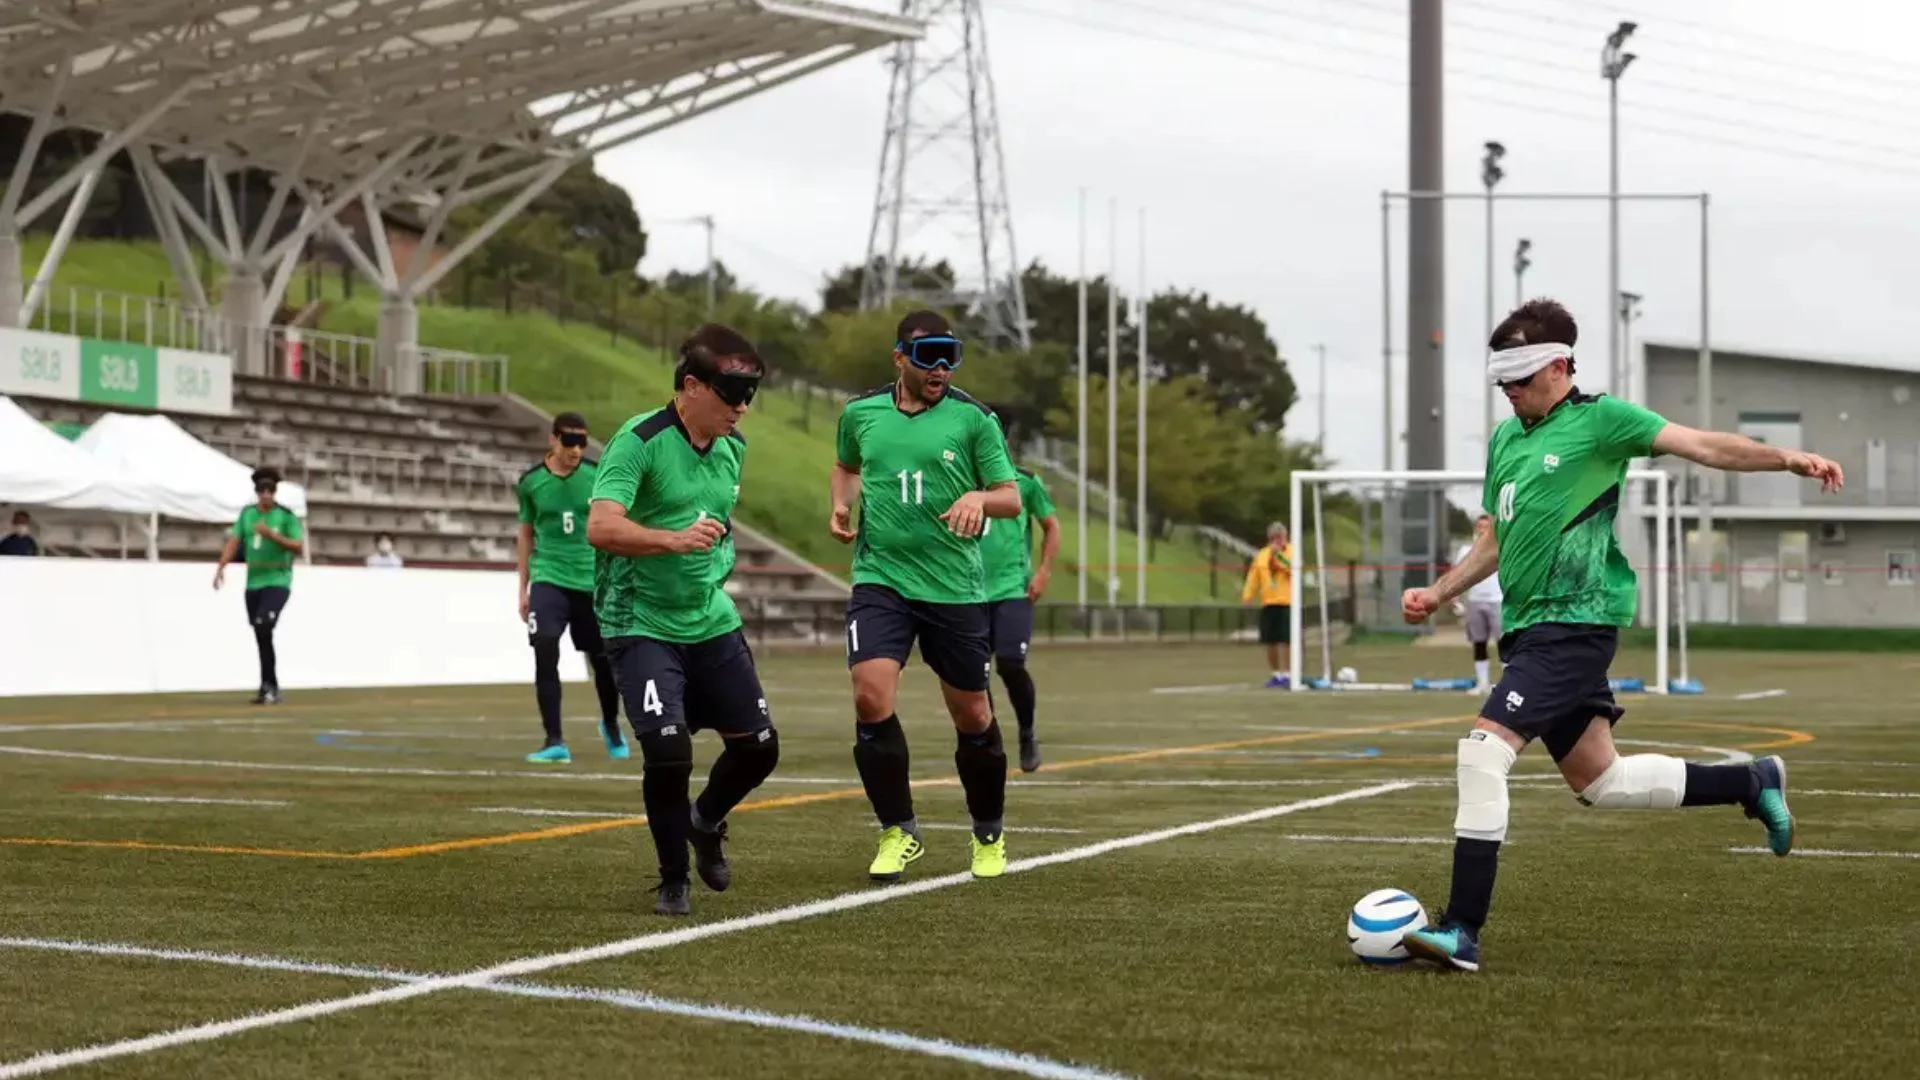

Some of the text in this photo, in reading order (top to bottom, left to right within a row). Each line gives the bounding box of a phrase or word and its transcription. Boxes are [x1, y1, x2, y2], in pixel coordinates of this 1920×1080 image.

[897, 469, 923, 504] 11
[562, 511, 575, 534] 5
[528, 611, 538, 634] 5
[643, 679, 664, 716] 4
